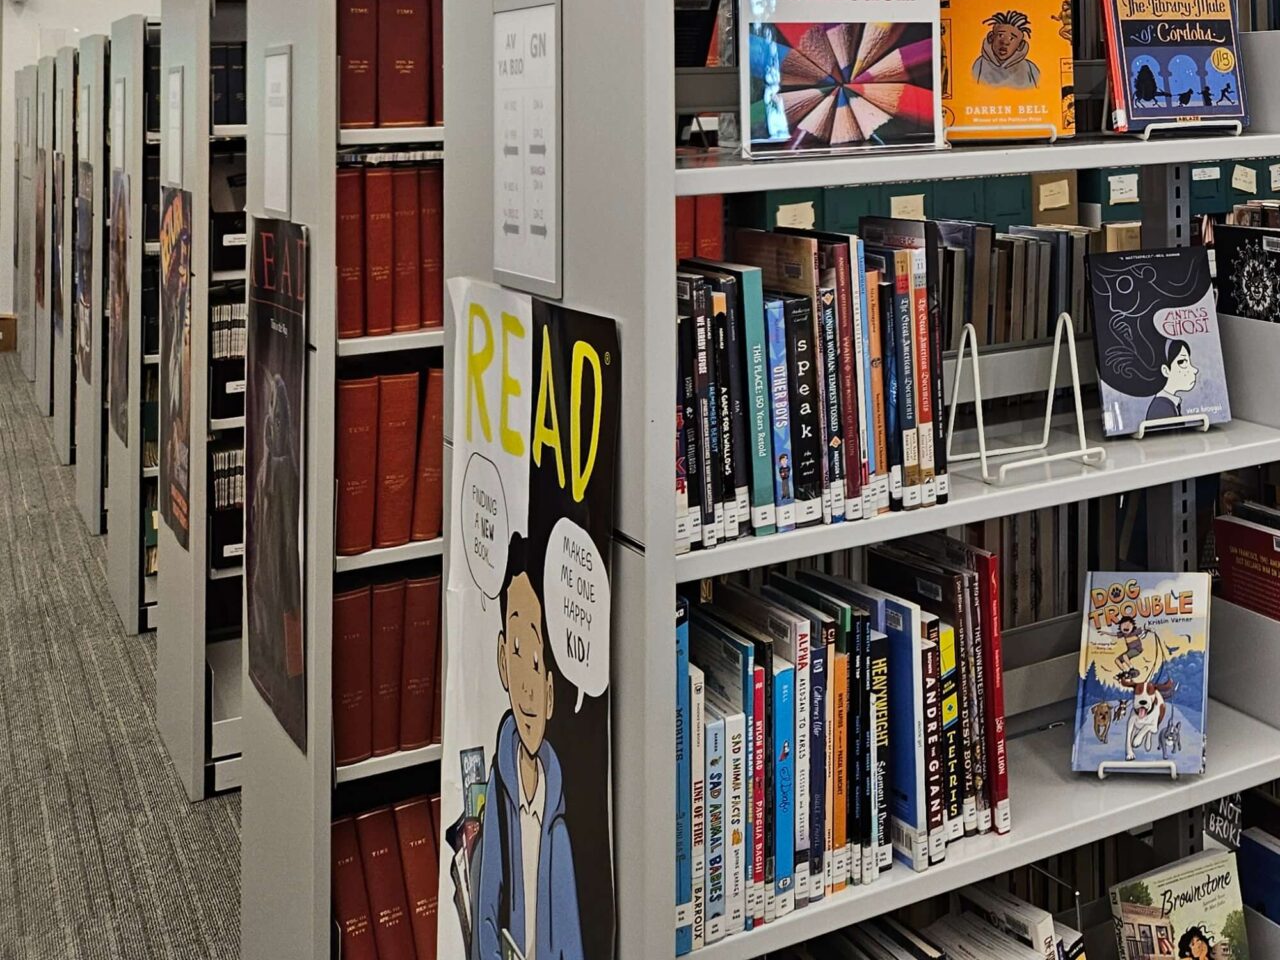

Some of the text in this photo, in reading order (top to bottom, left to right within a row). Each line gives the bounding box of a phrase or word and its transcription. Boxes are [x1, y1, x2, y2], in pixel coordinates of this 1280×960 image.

[530, 33, 547, 59] GN
[965, 105, 1048, 115] DARRIN BELL
[1162, 318, 1210, 337] GHOST
[1165, 308, 1208, 322] ANYA'S
[696, 316, 707, 374] WE HEREBY REFUSE
[824, 308, 838, 432] WONDER WOMAN: TEMPEST TOSSED
[465, 302, 602, 502] READ
[753, 344, 766, 457] THIS PLACE: Years Retold
[773, 365, 788, 428] OTHER BOYS
[723, 433, 731, 475] SWALLOWS
[473, 483, 498, 515] FINDING
[481, 515, 495, 542] NEW
[562, 535, 594, 572] MAKES
[560, 565, 595, 604] ME ONE
[1091, 579, 1140, 608] DOG
[563, 596, 592, 633] HAPPY
[1088, 590, 1193, 629] TROUBLE
[566, 626, 591, 669] KID!
[975, 646, 984, 696] UNWANTED
[798, 633, 808, 760] ALPHA ABIDJAN PARIS
[871, 658, 887, 747] HEAVYWEIGHT
[754, 720, 763, 770] NYLON ROAD
[925, 677, 941, 824] ANDRE GIANT
[961, 710, 972, 790] DUST BOWL
[997, 755, 1005, 775] LION
[731, 733, 743, 825] SAD ANIMAL FACTS
[877, 761, 885, 800] Solomon
[946, 731, 959, 816] TETRIS
[693, 780, 703, 847] LINE FIRE
[709, 772, 723, 903] SAD ANIMAL BABIES
[693, 887, 703, 941] BARROUX
[1161, 874, 1232, 917] Brownstone
